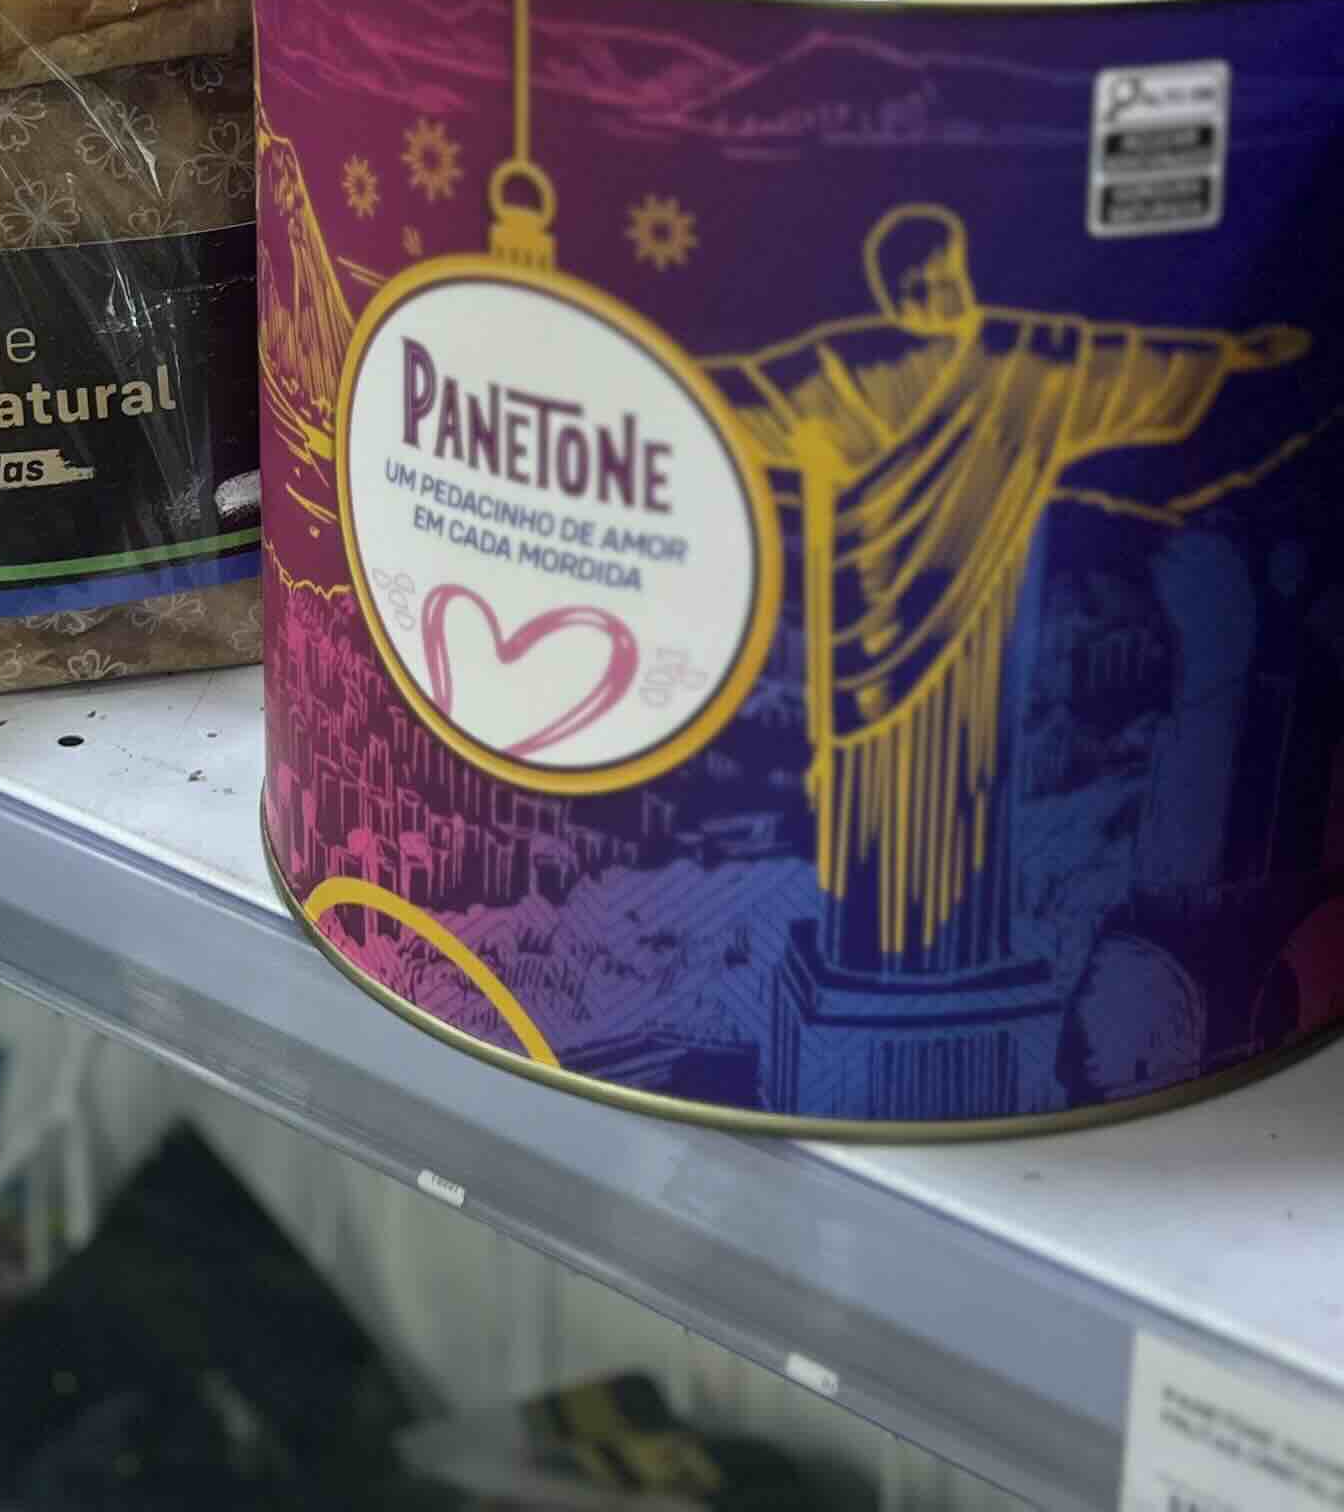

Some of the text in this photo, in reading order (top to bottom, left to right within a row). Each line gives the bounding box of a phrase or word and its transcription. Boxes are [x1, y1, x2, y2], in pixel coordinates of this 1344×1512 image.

[402, 335, 673, 514] PANETONE
[384, 458, 689, 565] UM PEDACINHO DE AMOR
[413, 506, 643, 590] EM CADA MORDIDA
